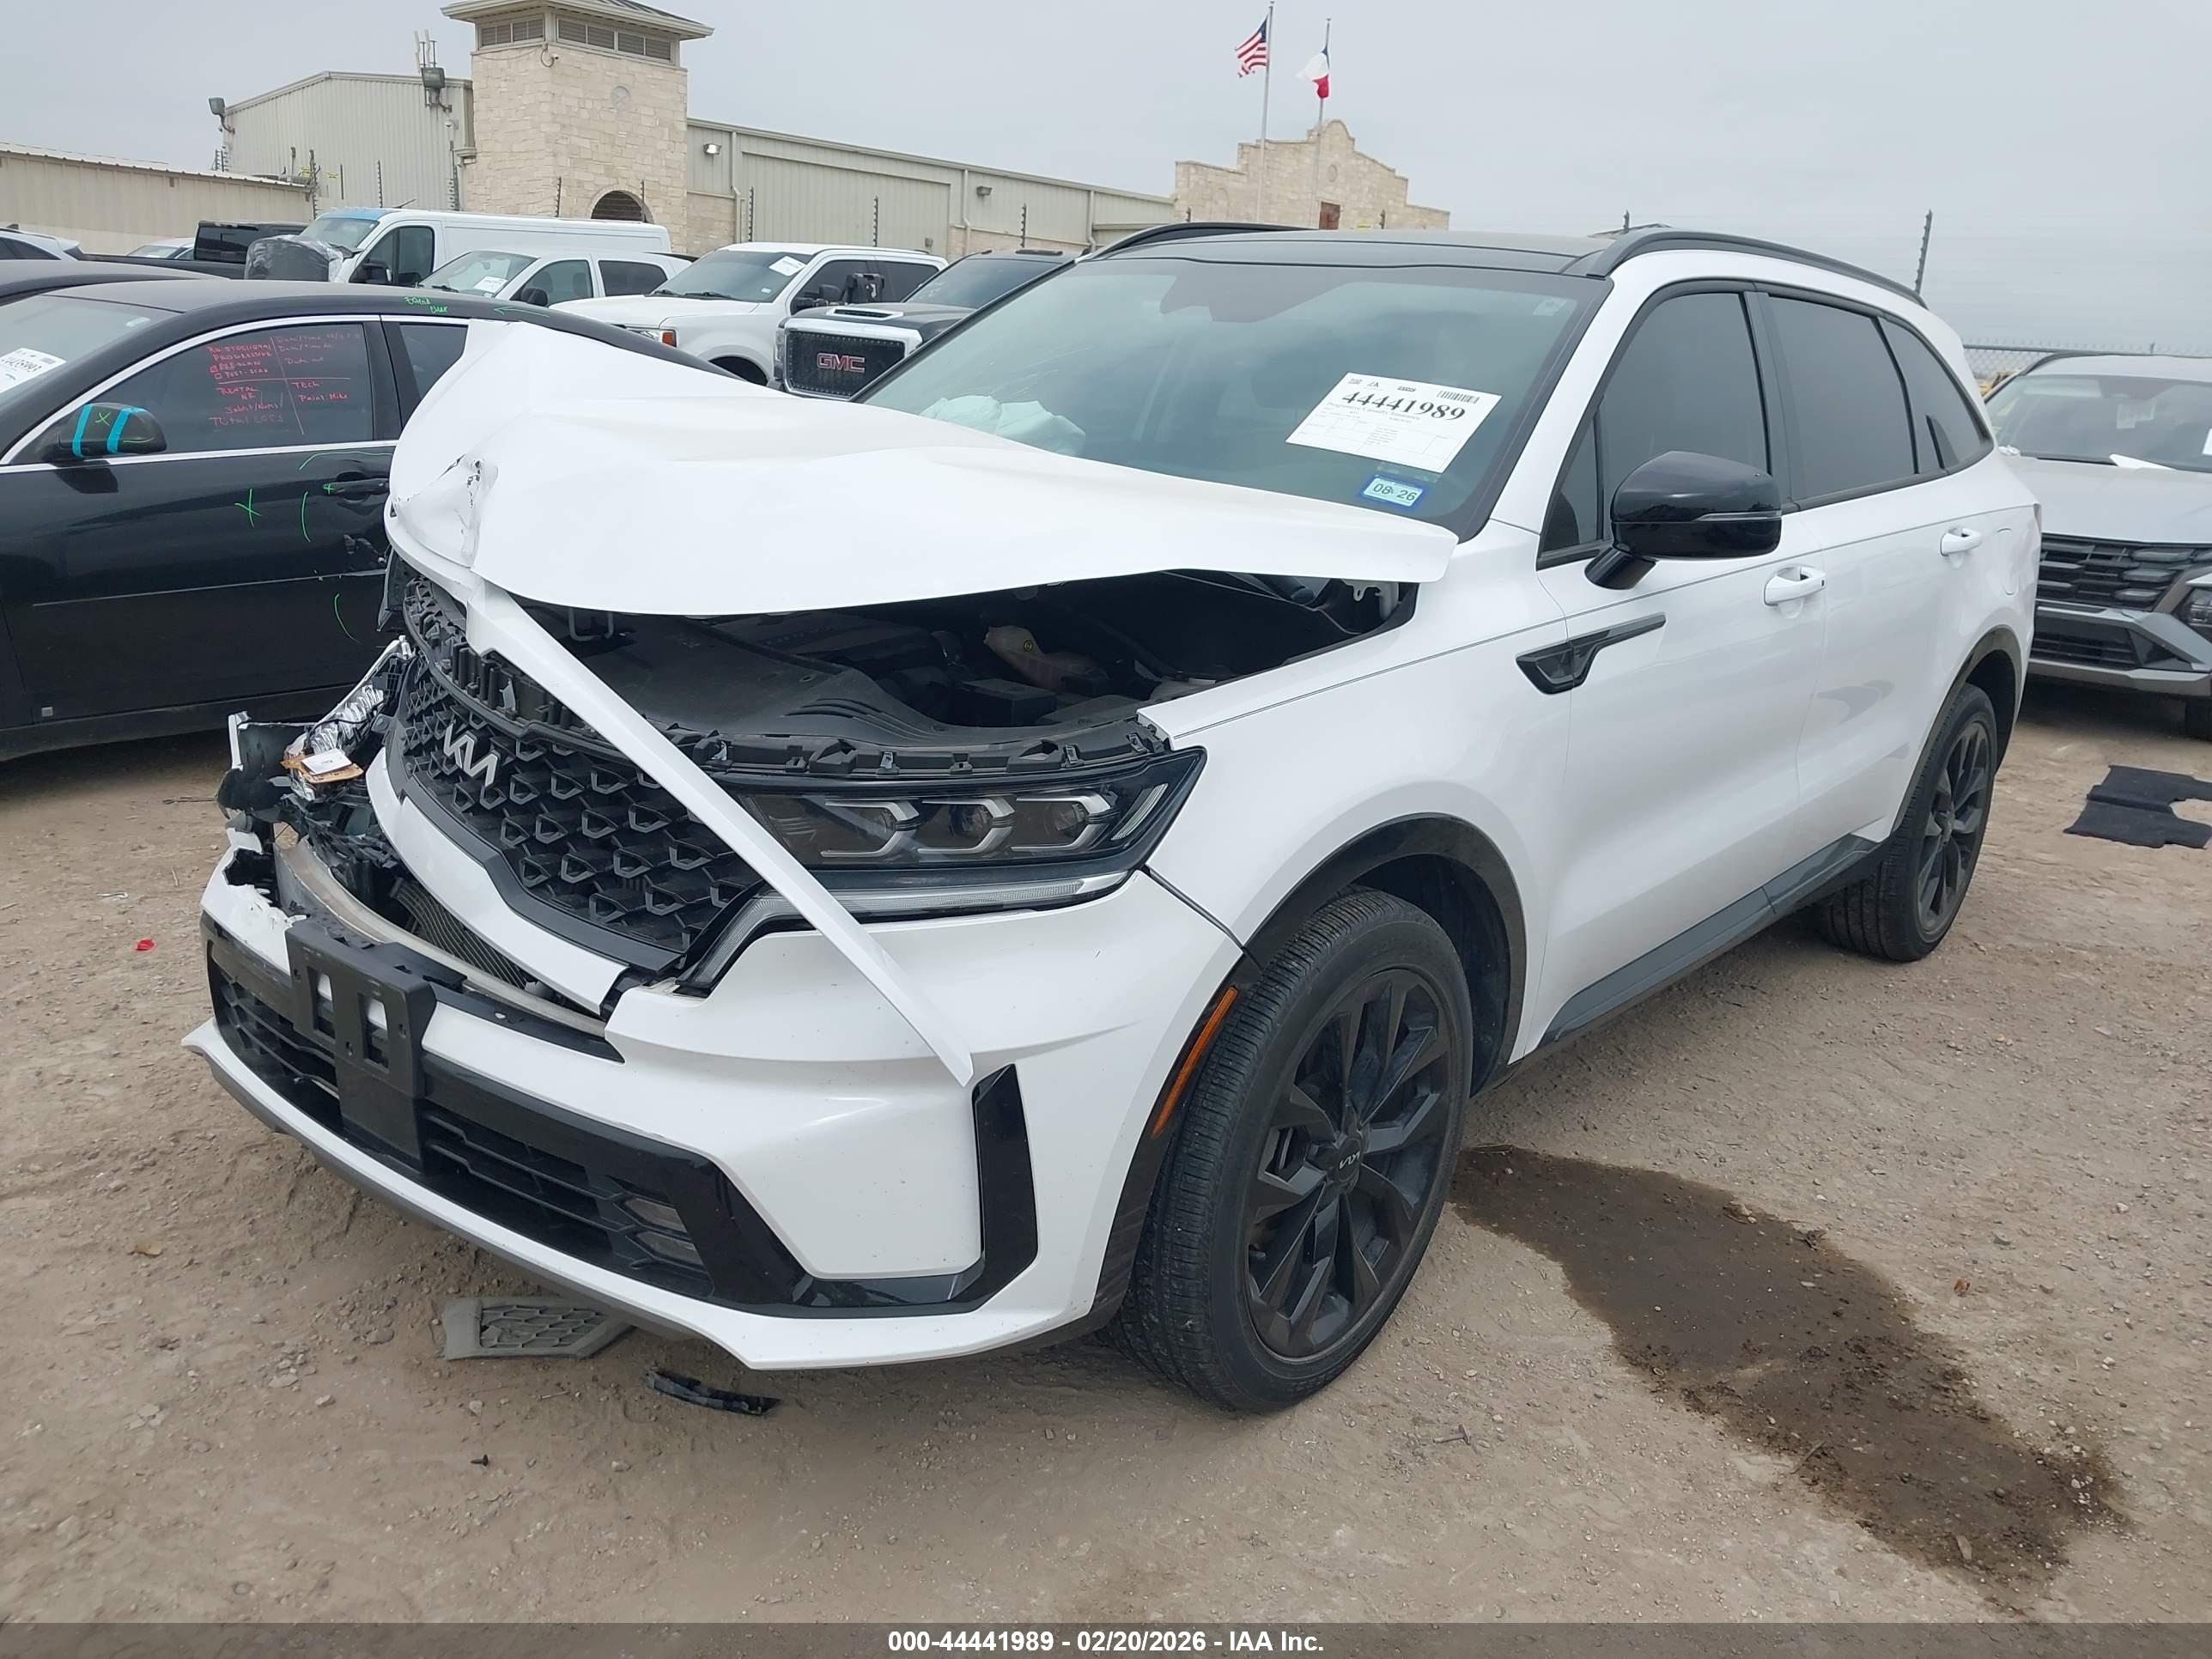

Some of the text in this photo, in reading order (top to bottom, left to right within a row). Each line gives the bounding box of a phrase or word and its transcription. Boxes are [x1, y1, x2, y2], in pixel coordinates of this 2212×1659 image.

[817, 352, 866, 373] GMC
[1341, 391, 1466, 421] 44441989
[1372, 483, 1418, 501] 08 26
